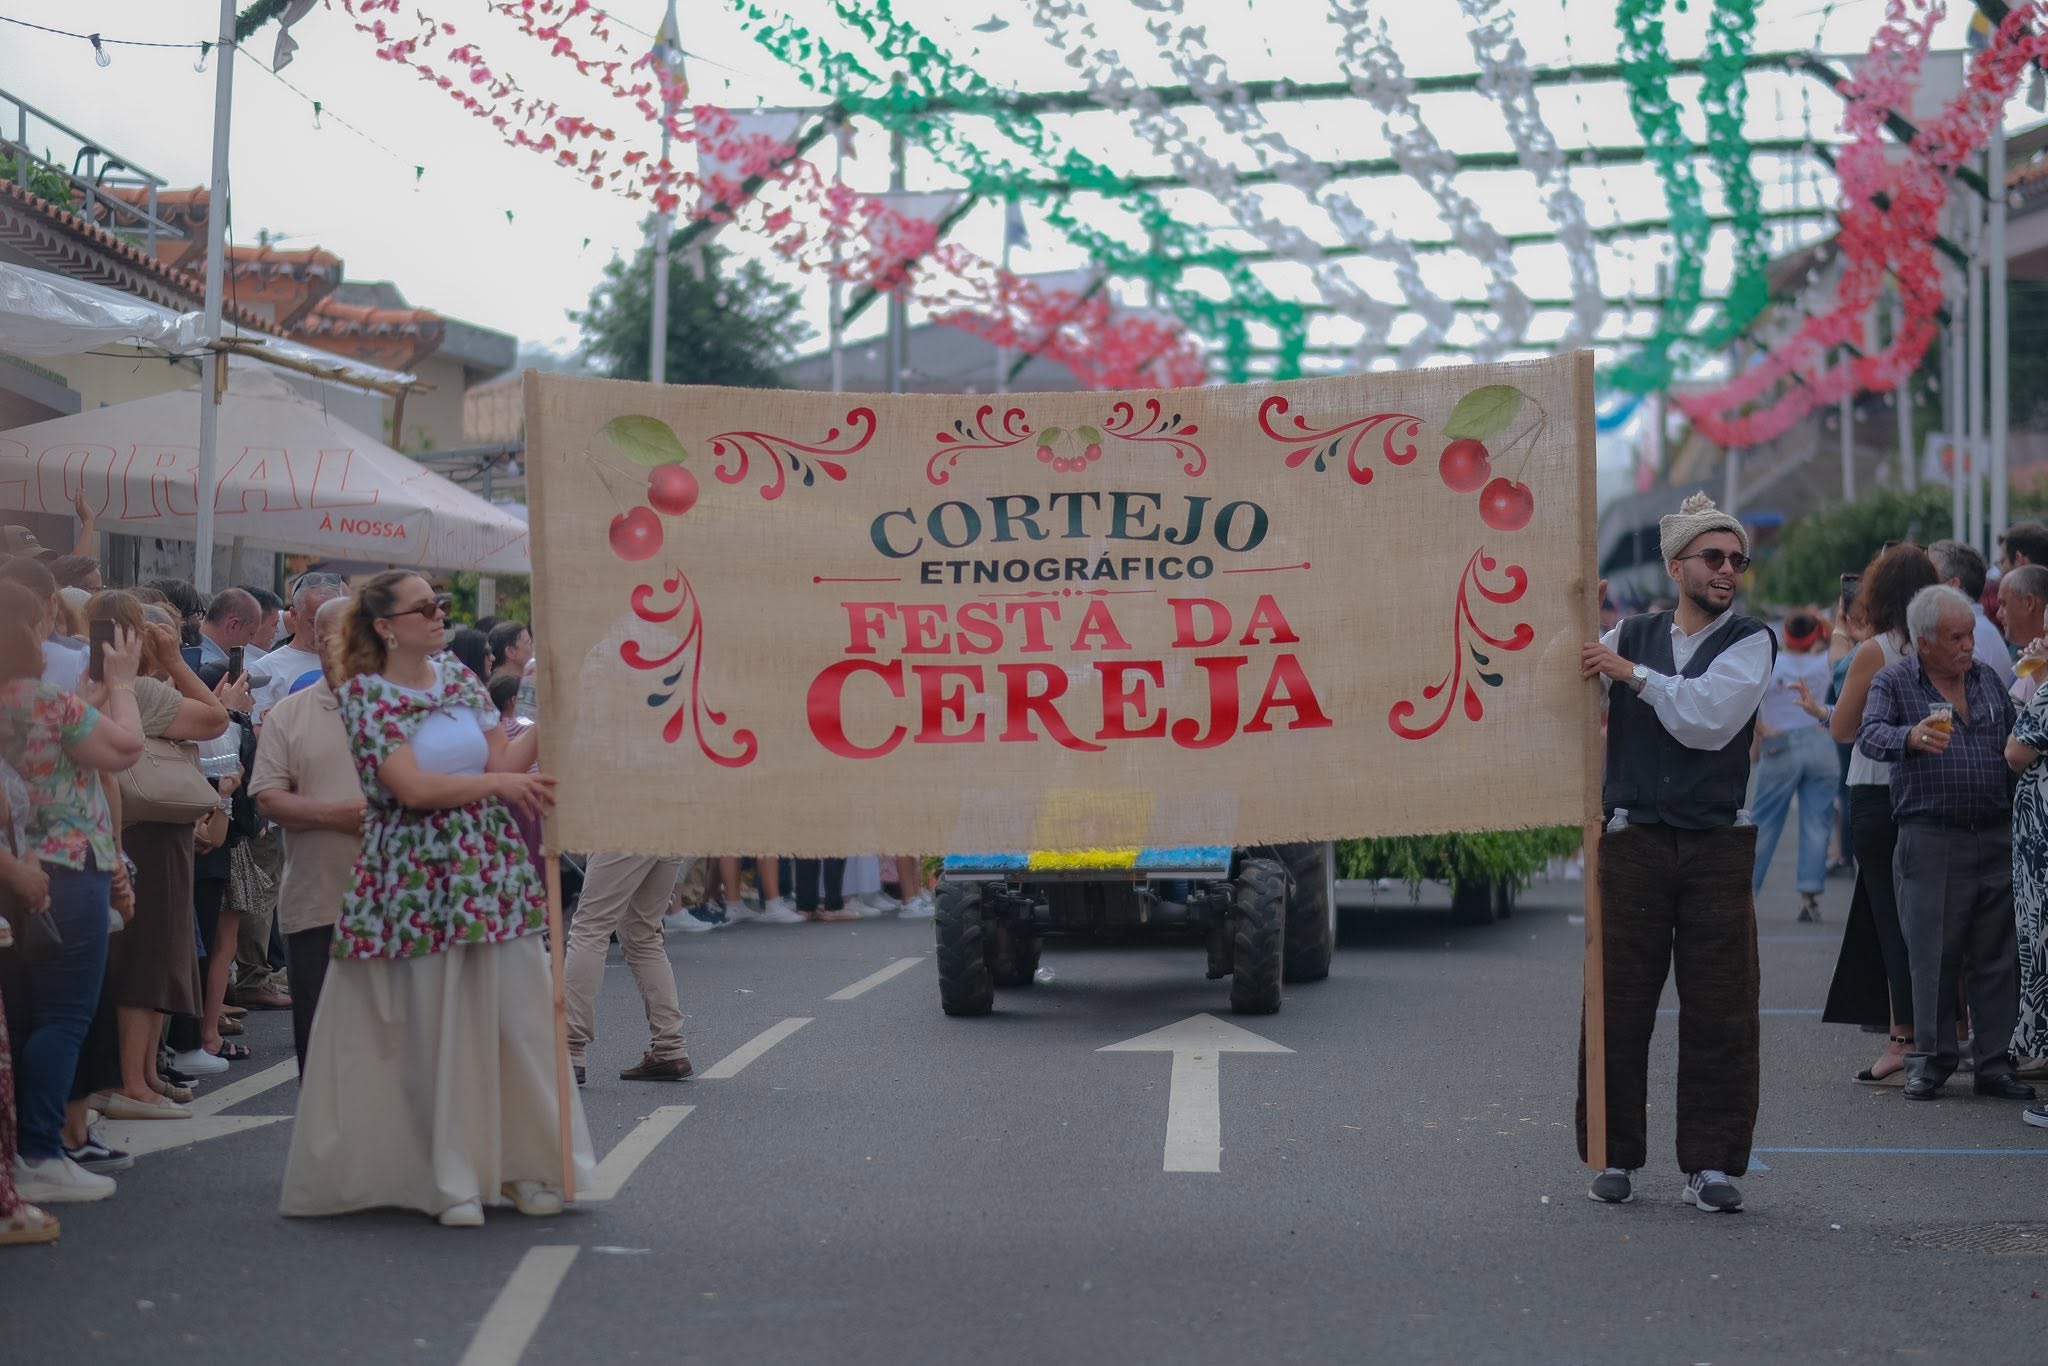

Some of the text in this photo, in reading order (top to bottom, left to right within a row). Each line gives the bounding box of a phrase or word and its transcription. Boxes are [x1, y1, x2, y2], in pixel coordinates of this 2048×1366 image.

[340, 517, 406, 539] NOSSA
[870, 491, 1270, 559] CORTEJO
[920, 551, 1215, 585] ETNOGRÁFICO
[841, 594, 1300, 655] FESTA DA
[806, 653, 1333, 760] CEREJA
